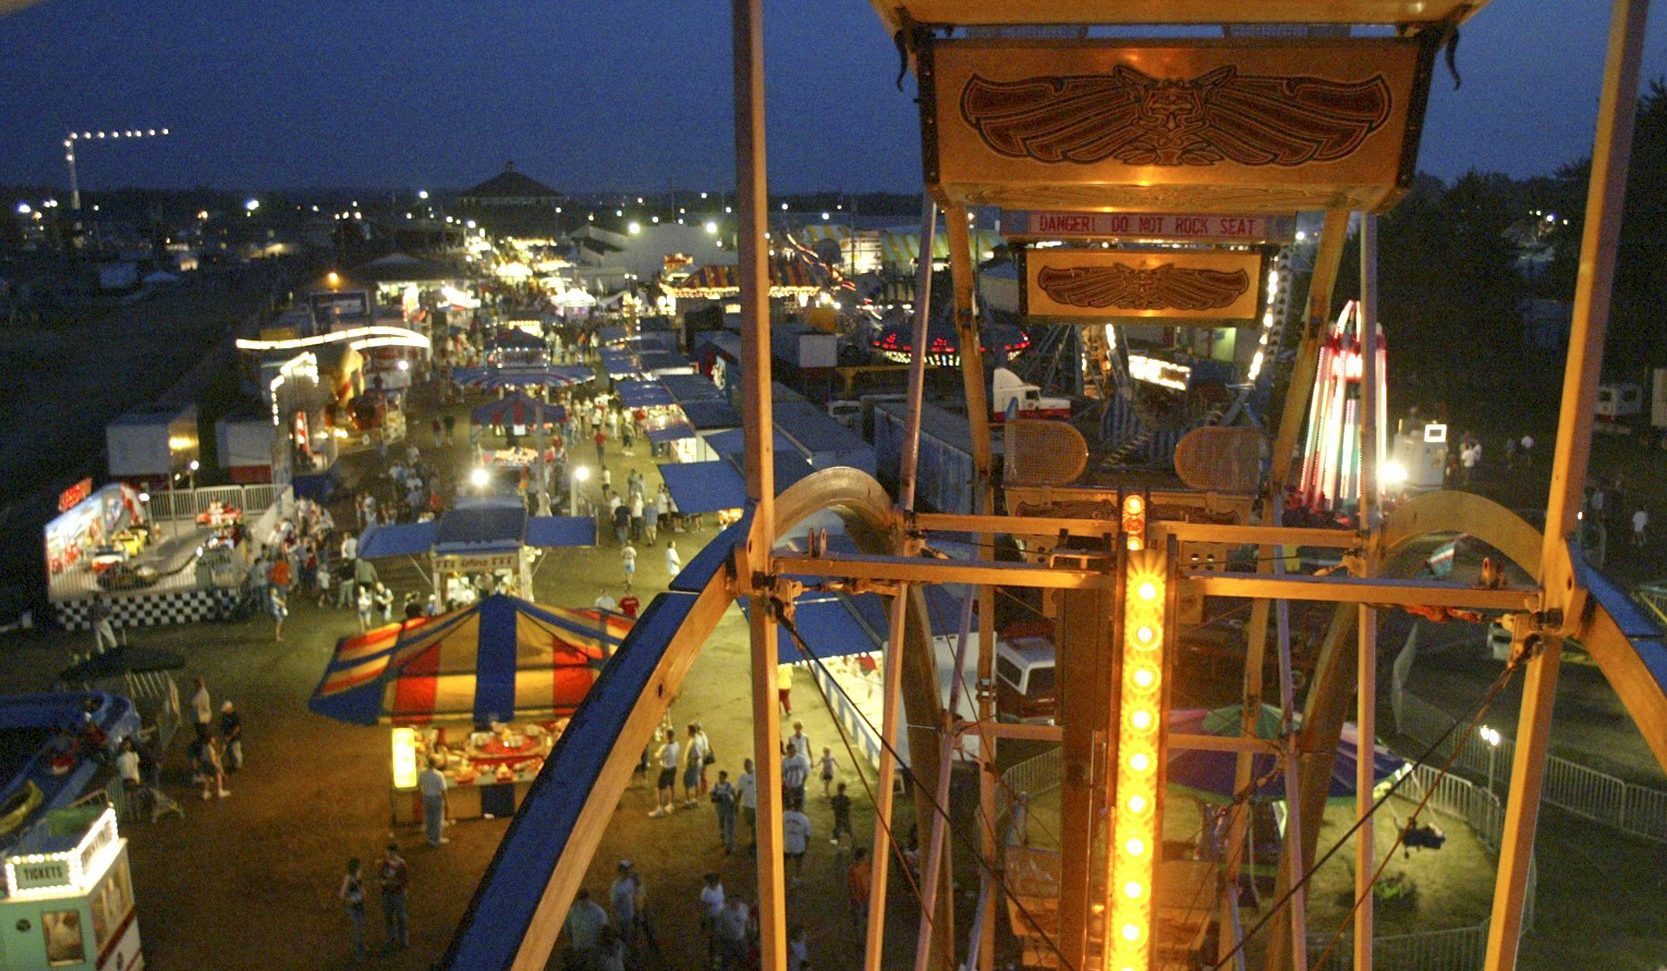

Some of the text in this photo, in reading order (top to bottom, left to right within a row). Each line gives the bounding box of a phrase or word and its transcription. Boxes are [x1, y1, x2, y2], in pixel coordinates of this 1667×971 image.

[1039, 214, 1256, 235] DANGER! DO NOT ROCK SEAT
[24, 865, 63, 881] TICKETS
